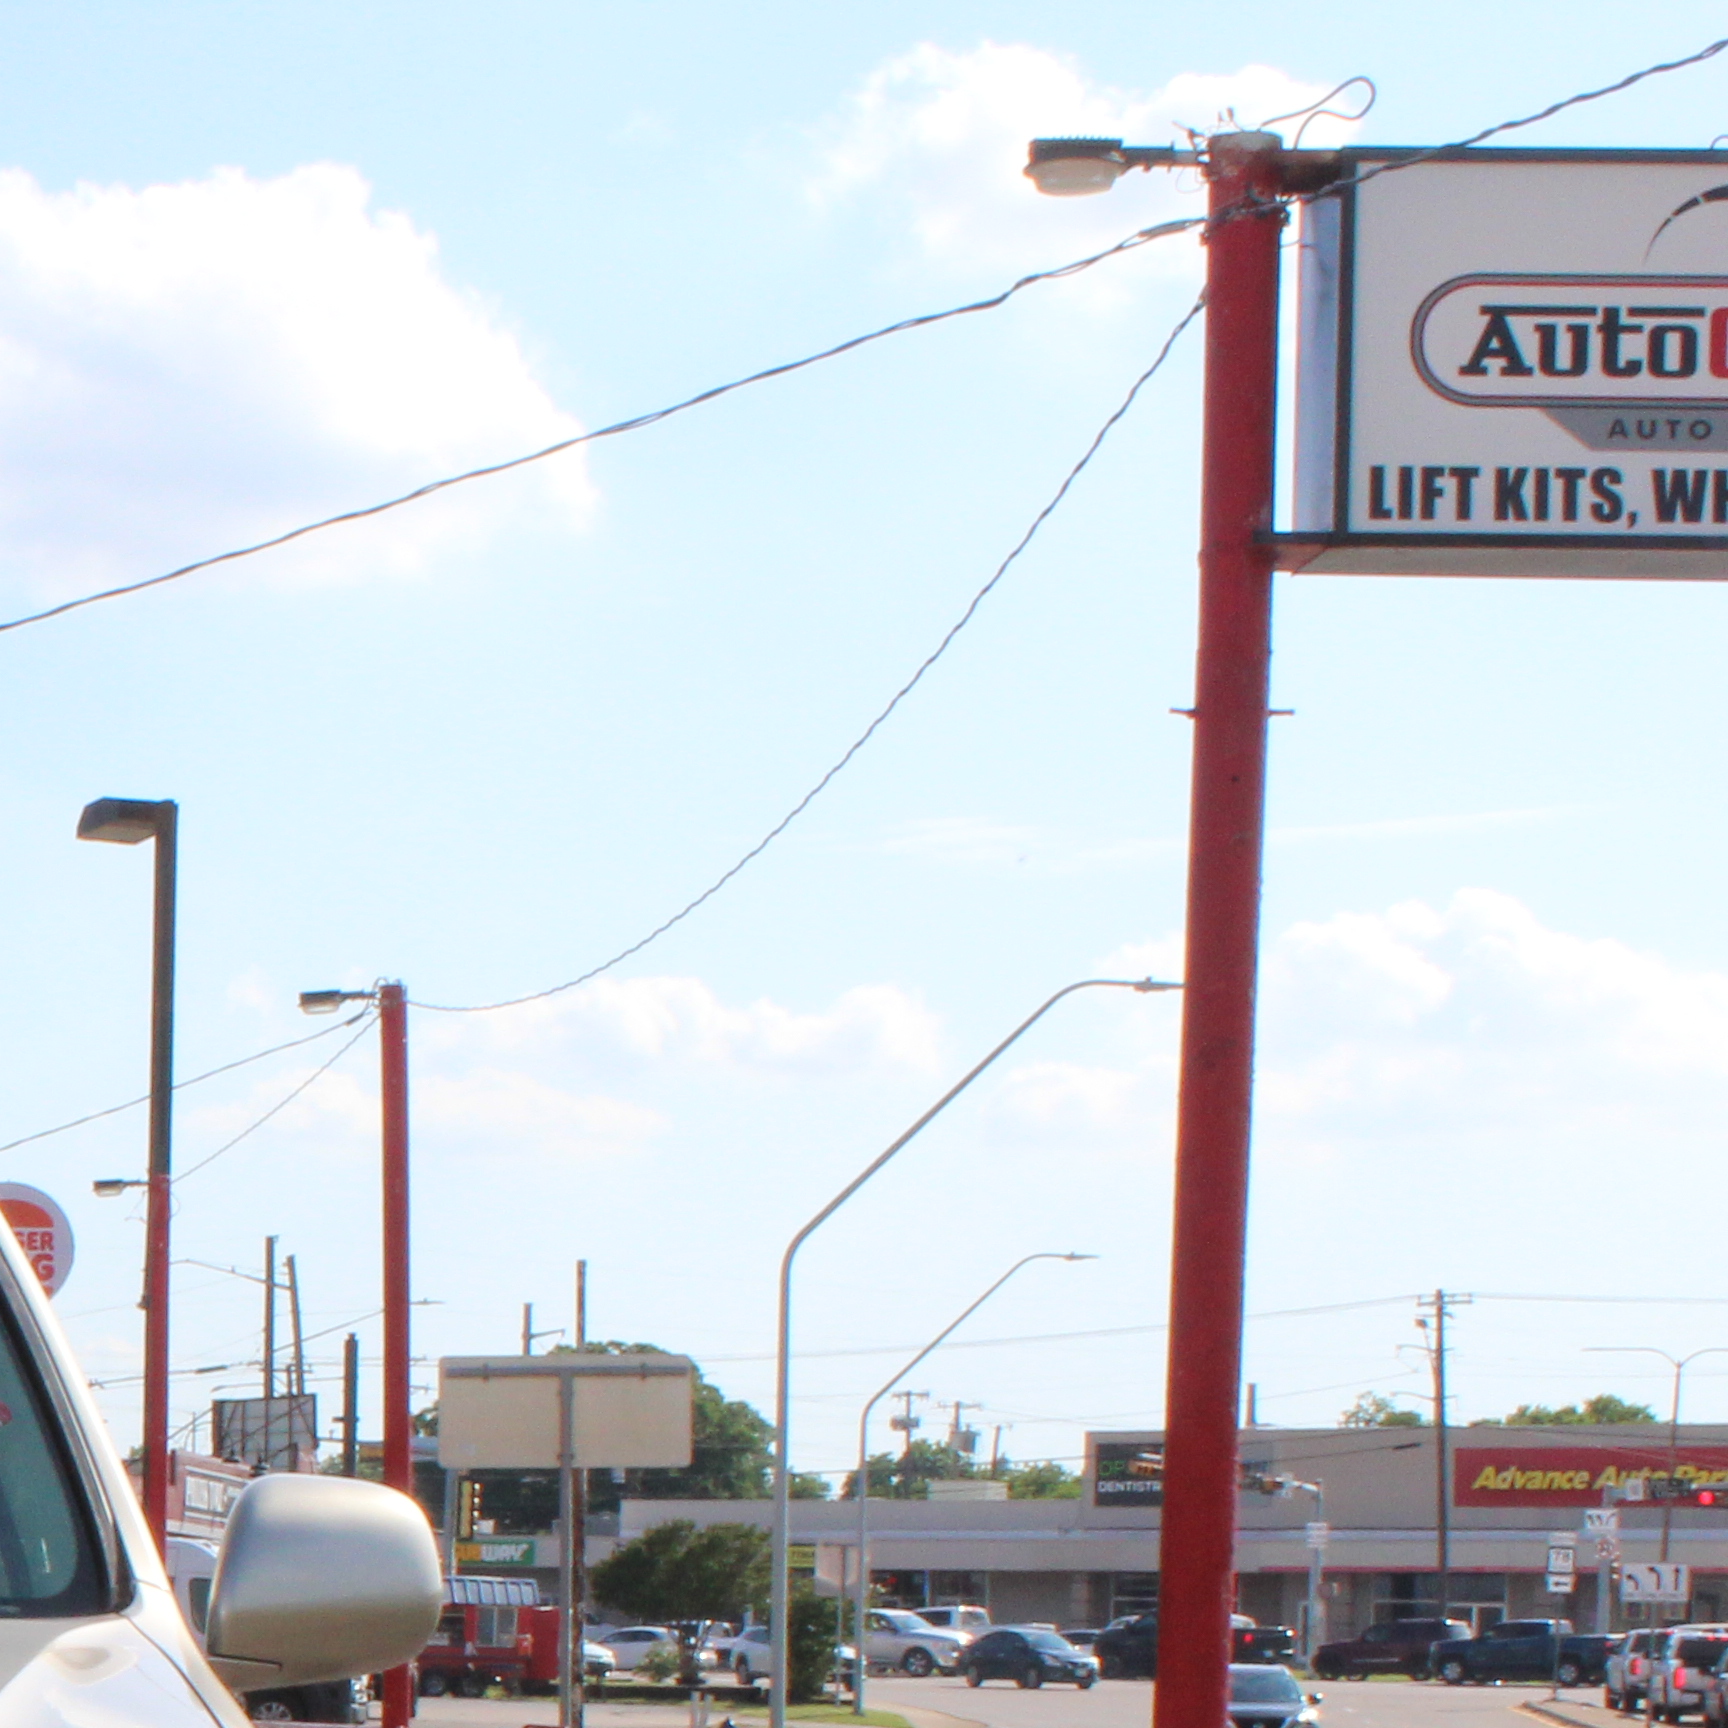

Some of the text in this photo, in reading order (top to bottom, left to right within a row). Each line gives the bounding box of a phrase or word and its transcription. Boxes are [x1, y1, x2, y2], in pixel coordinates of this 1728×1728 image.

[1607, 418, 1712, 440] AUTO
[1369, 465, 1480, 522] LIFT
[1493, 466, 1638, 528] KITS,
[1472, 1465, 1591, 1490] Advance
